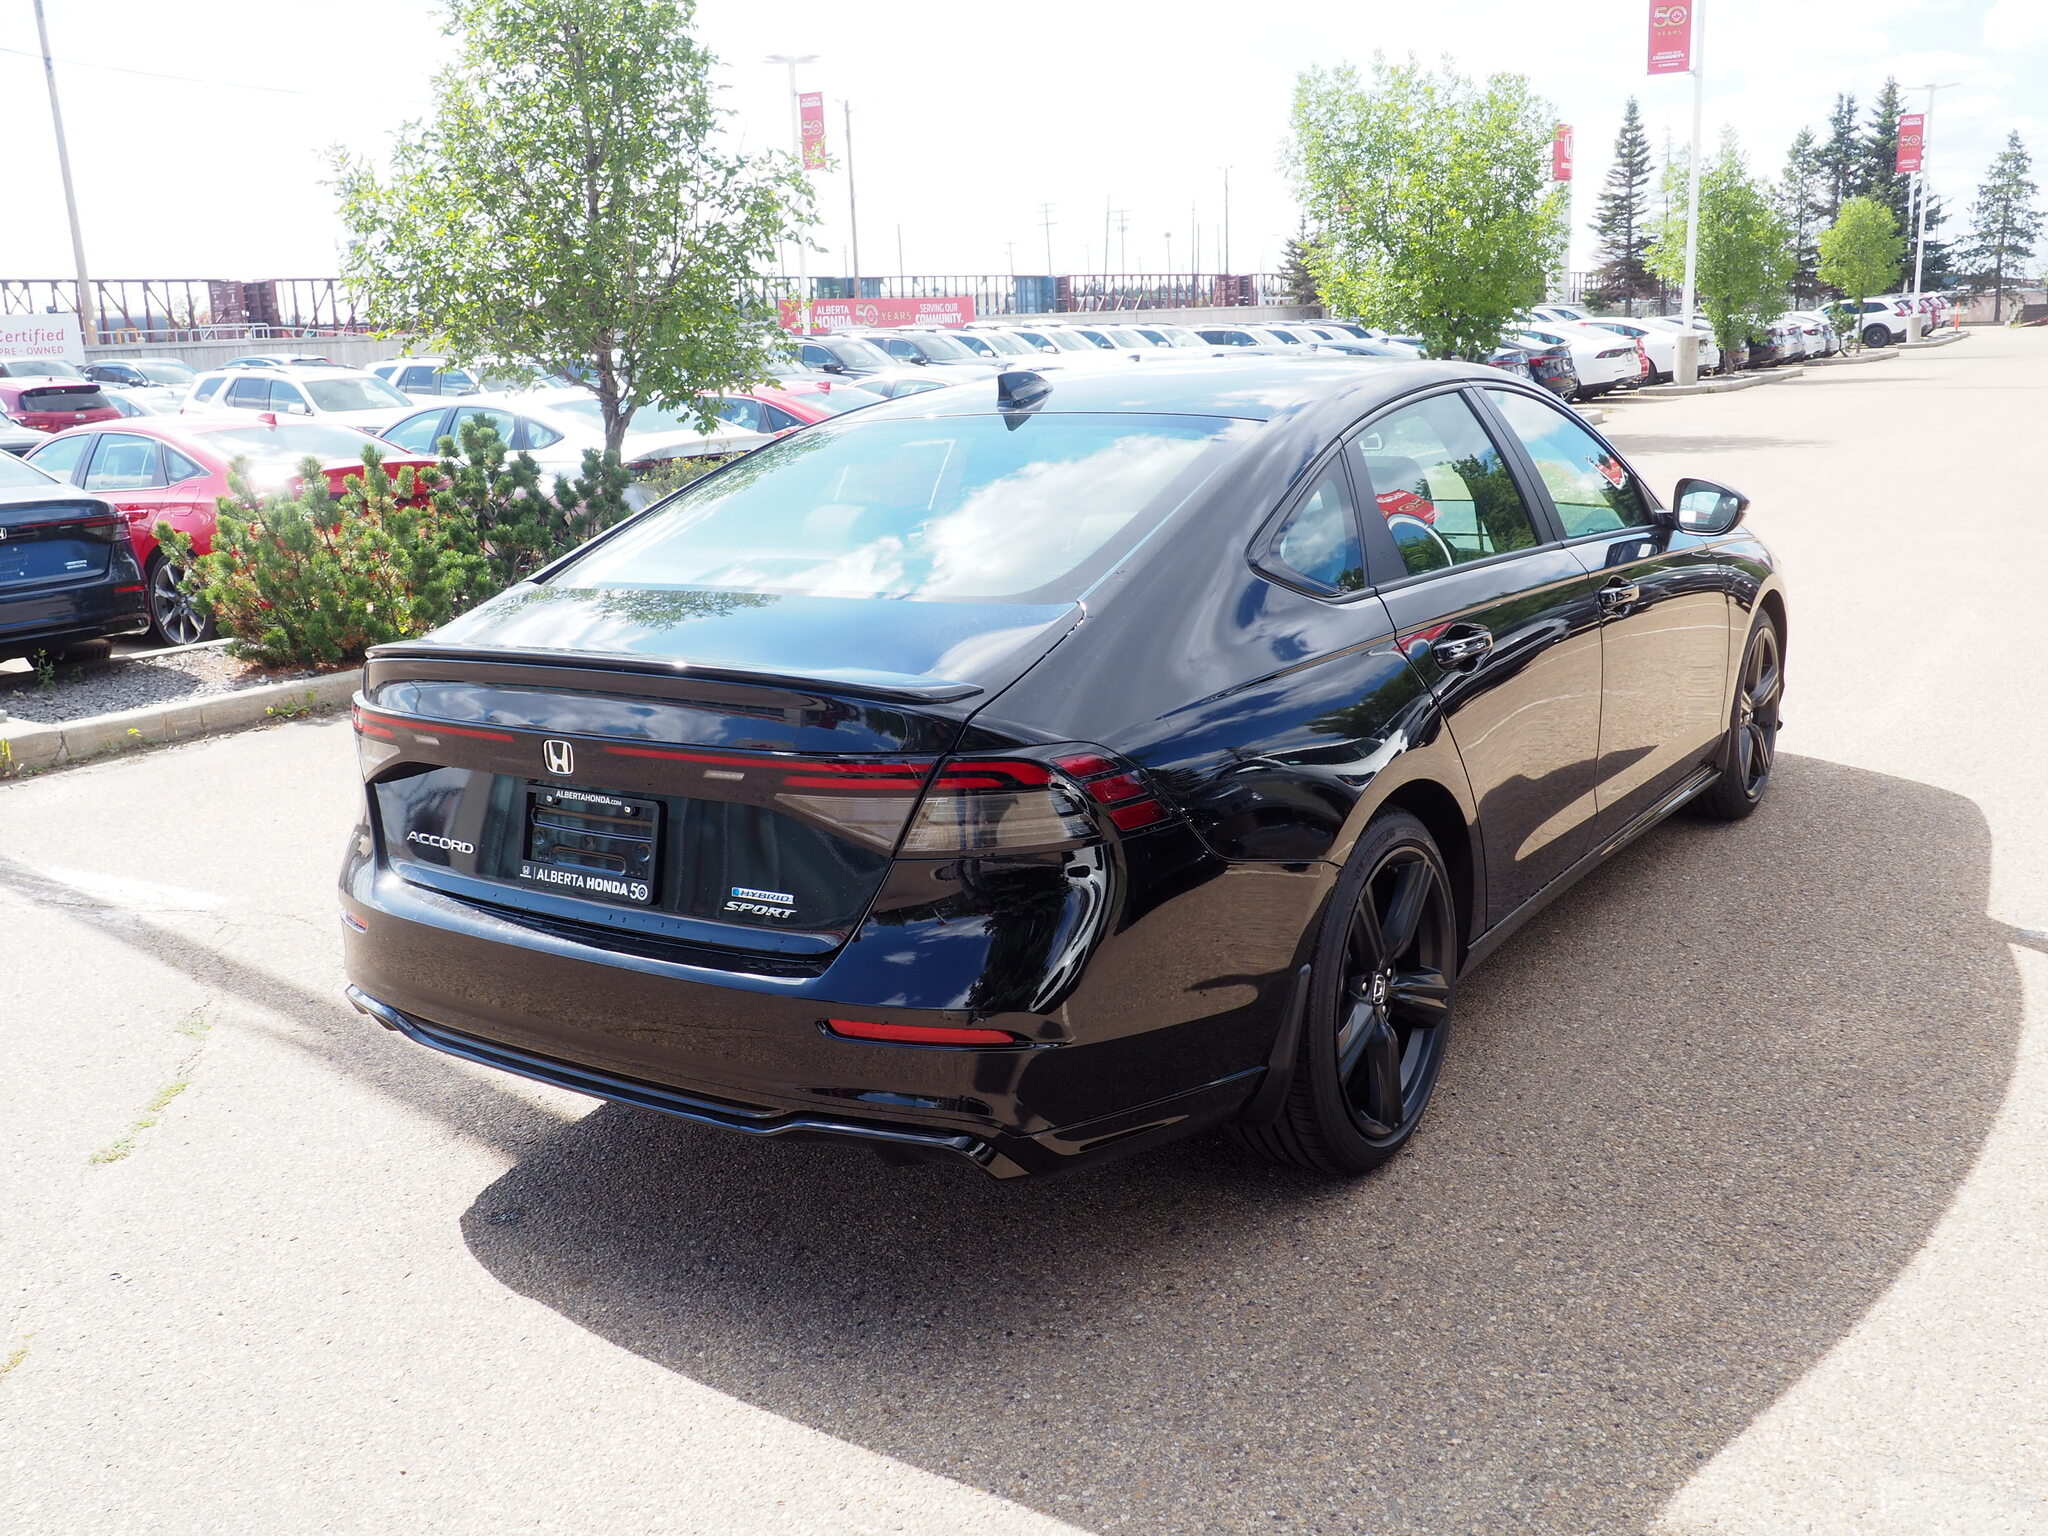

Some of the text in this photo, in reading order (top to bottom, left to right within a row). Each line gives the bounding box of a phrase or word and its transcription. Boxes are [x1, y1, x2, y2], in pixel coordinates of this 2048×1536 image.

[817, 305, 850, 315] ALBERTA
[920, 302, 958, 313] SERVING OUR
[815, 315, 853, 328] HONDA
[881, 311, 912, 321] YEARS
[26, 346, 65, 355] OWNED
[406, 830, 475, 854] ACCORD
[536, 868, 648, 900] ALBERTA HONDA 50
[740, 889, 791, 902] HYBRID
[723, 900, 797, 919] SPORT
